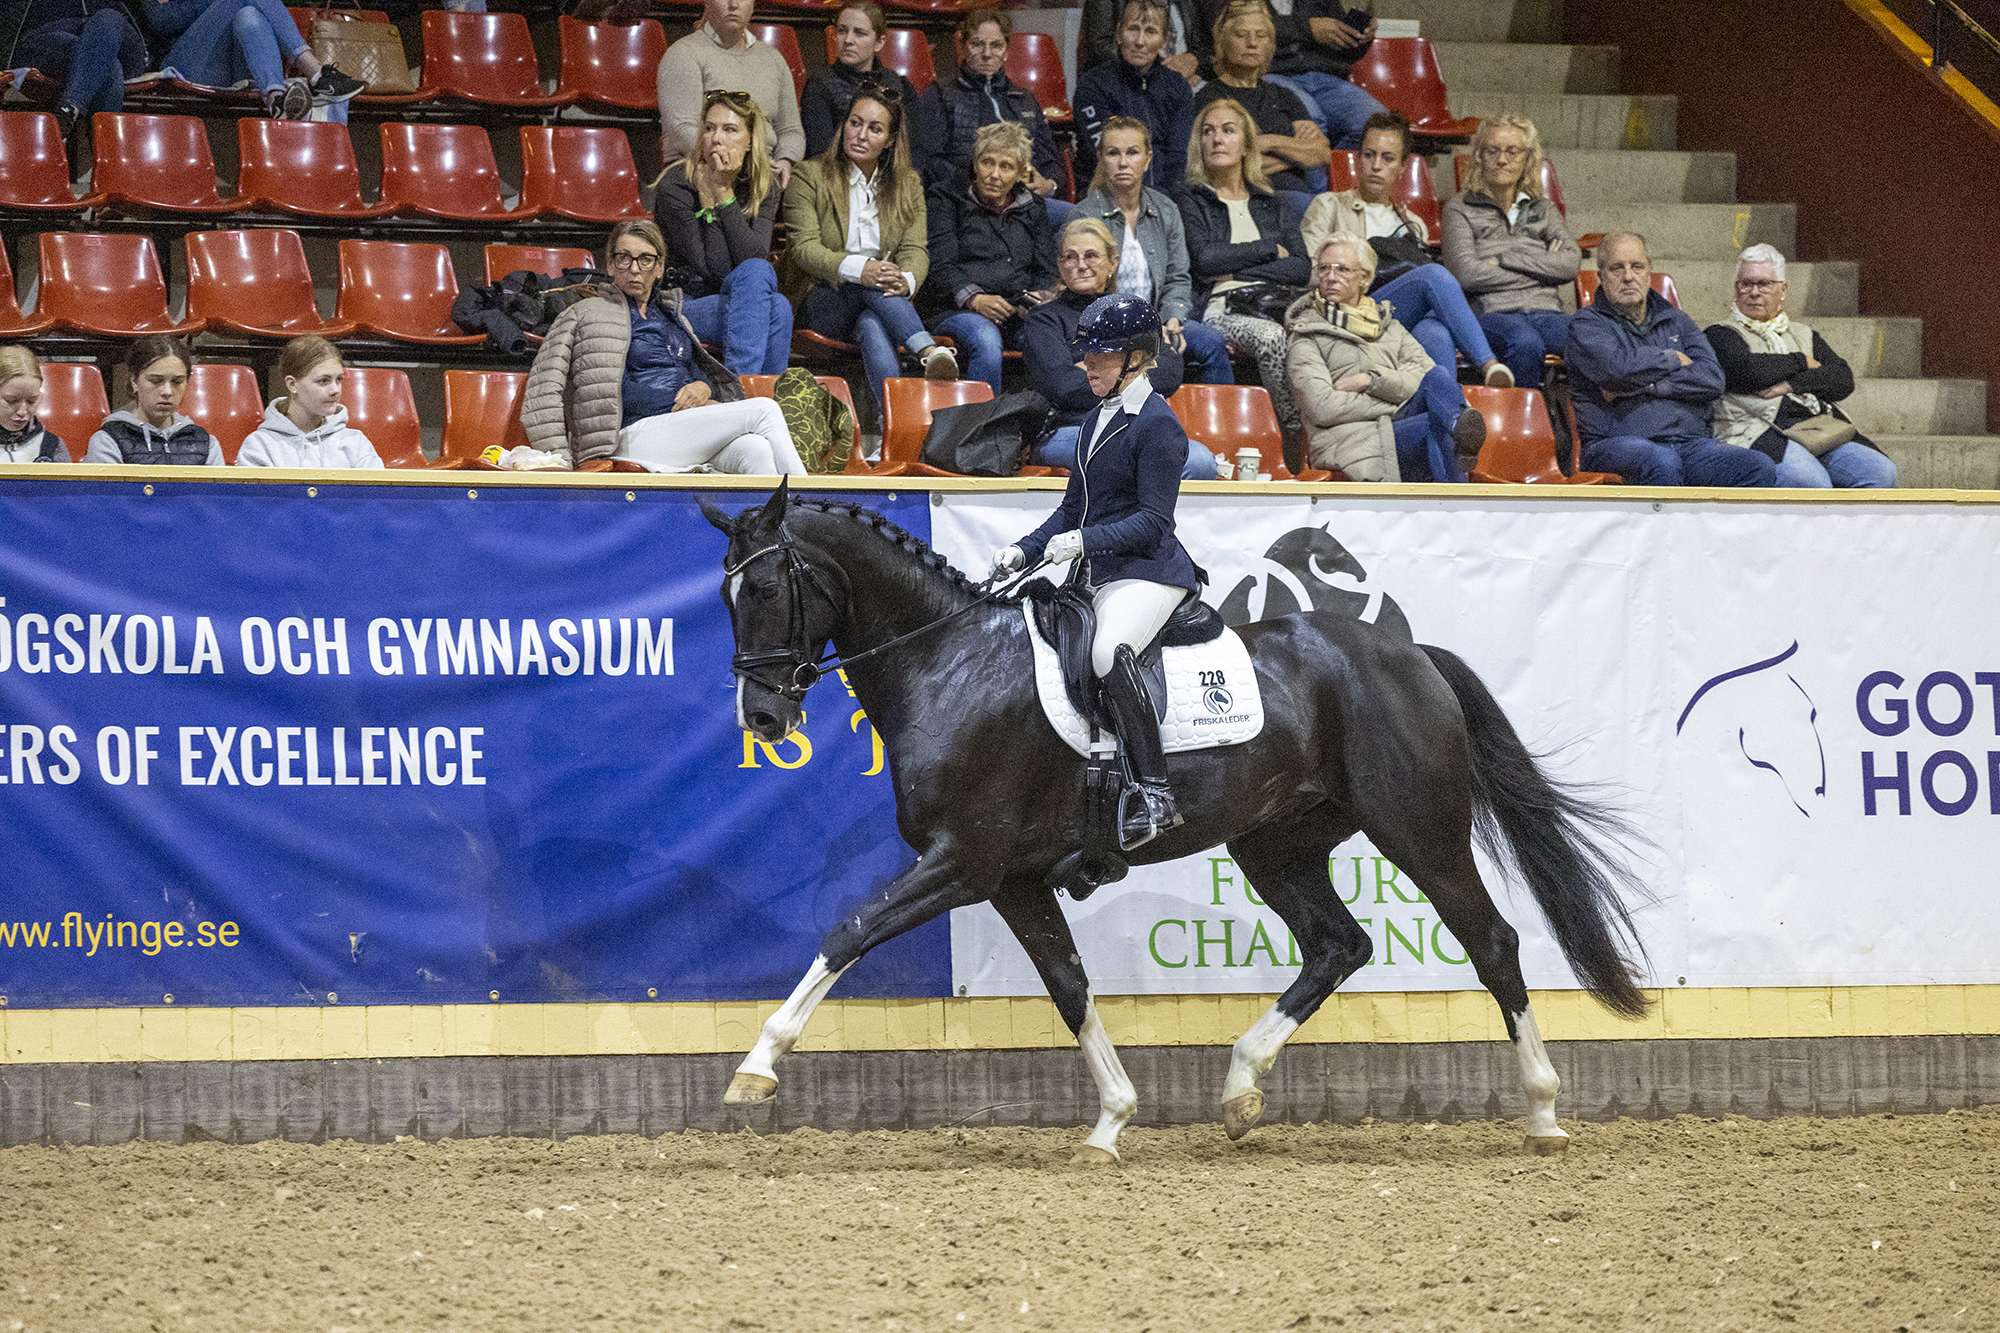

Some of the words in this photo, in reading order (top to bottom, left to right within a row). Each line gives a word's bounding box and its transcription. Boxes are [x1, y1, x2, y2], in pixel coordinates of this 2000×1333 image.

[240, 617, 350, 675] OCH
[367, 617, 675, 676] GYMNASIUM
[1198, 670, 1226, 686] 228
[0, 725, 80, 785] RS
[96, 726, 160, 785] OF
[179, 726, 487, 786] EXCELLENCE
